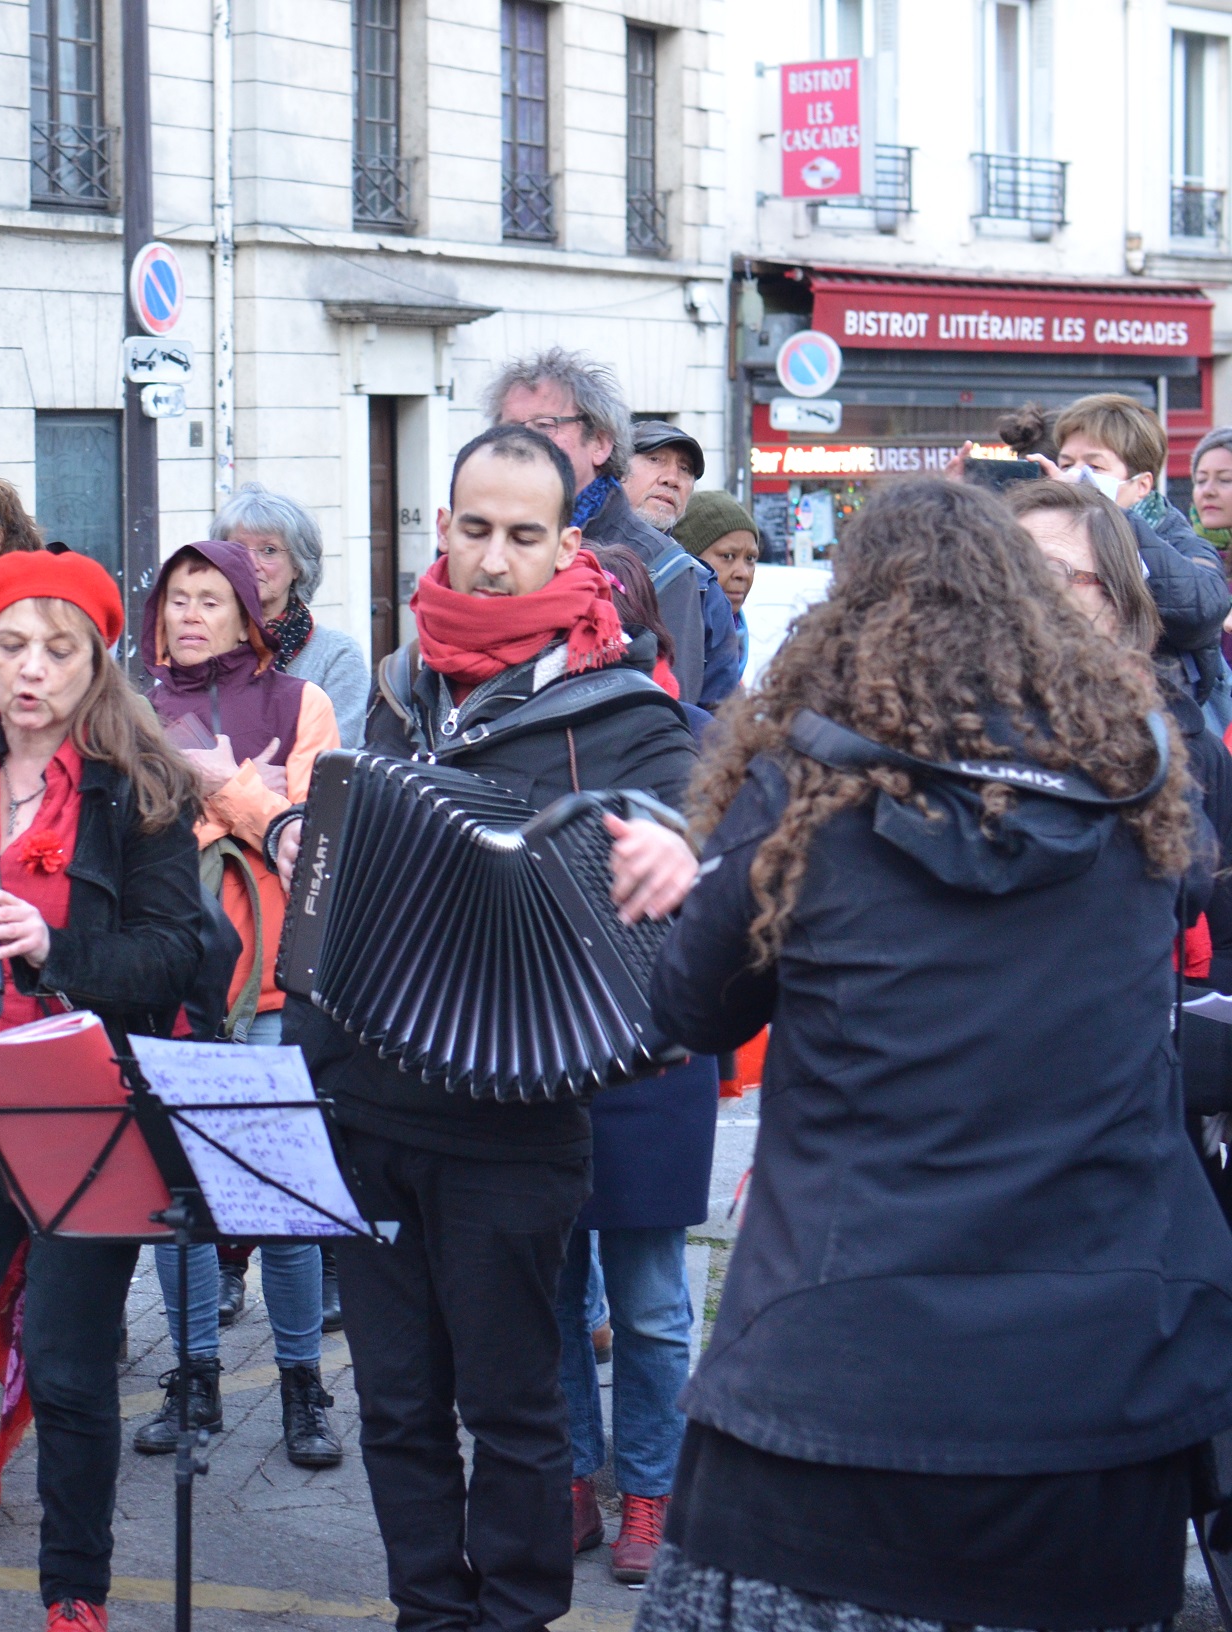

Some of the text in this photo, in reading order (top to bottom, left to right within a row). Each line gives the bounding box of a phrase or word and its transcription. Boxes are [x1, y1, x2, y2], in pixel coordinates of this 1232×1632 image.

[789, 66, 853, 94] BISTROT
[807, 101, 835, 125] LES
[782, 124, 860, 152] CASCADES
[844, 310, 1189, 346] BISTROT LITTÉRAIRE LES CASCADES
[400, 508, 422, 526] 84
[959, 761, 1067, 791] LUMIX
